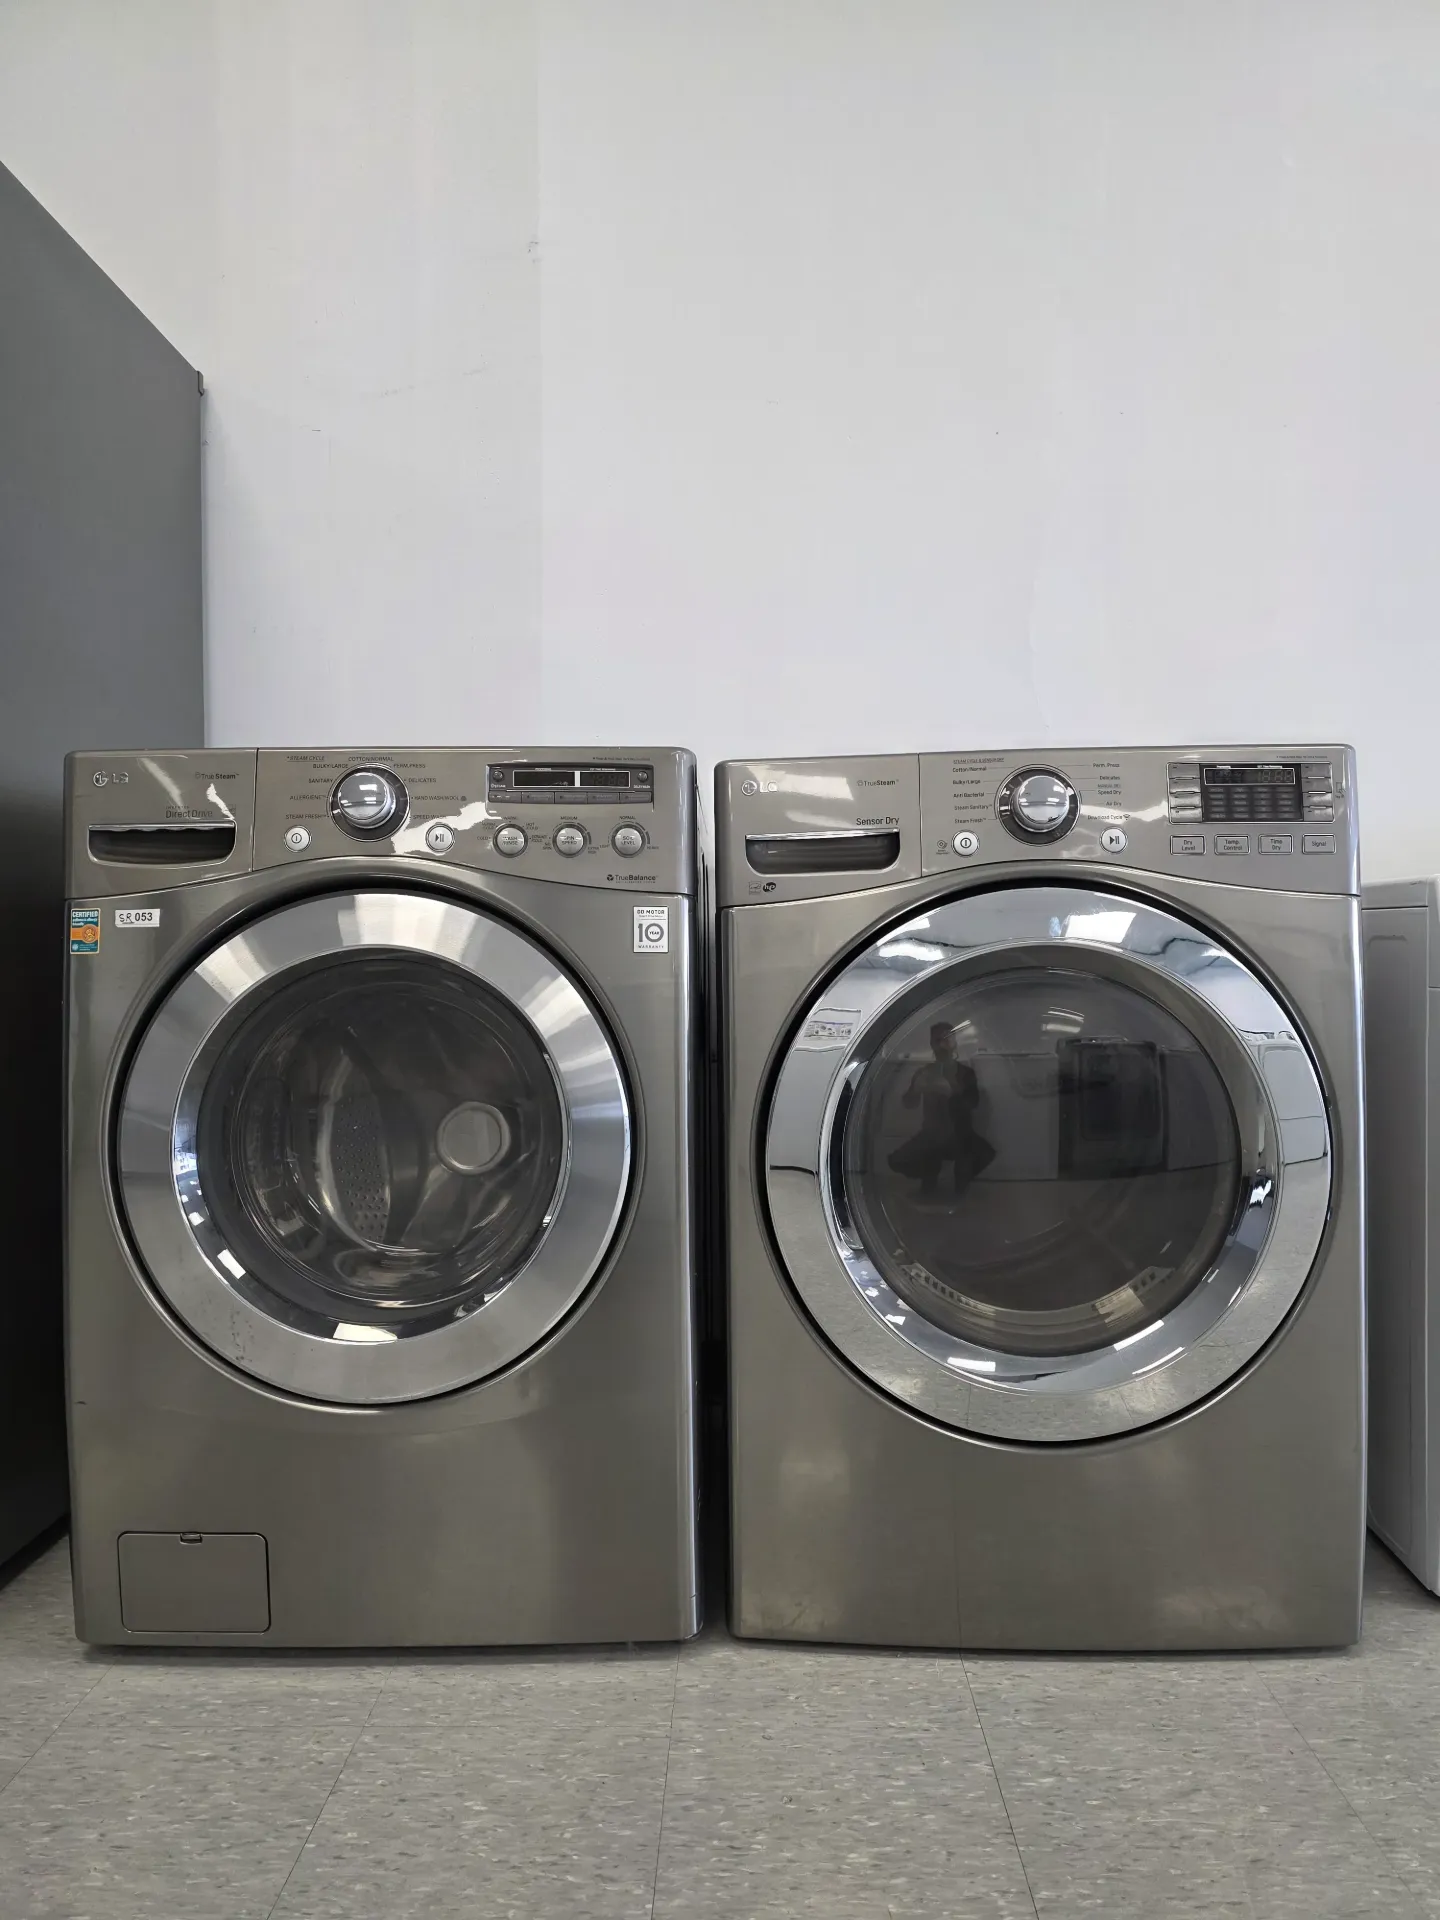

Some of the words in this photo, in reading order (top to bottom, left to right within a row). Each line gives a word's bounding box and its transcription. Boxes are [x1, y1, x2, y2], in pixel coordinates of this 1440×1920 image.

[165, 810, 190, 819] Direct
[191, 809, 213, 818] Drive
[856, 817, 884, 826] Sensor
[885, 816, 900, 827] Dry
[134, 912, 153, 922] 053
[638, 922, 664, 942] 10
